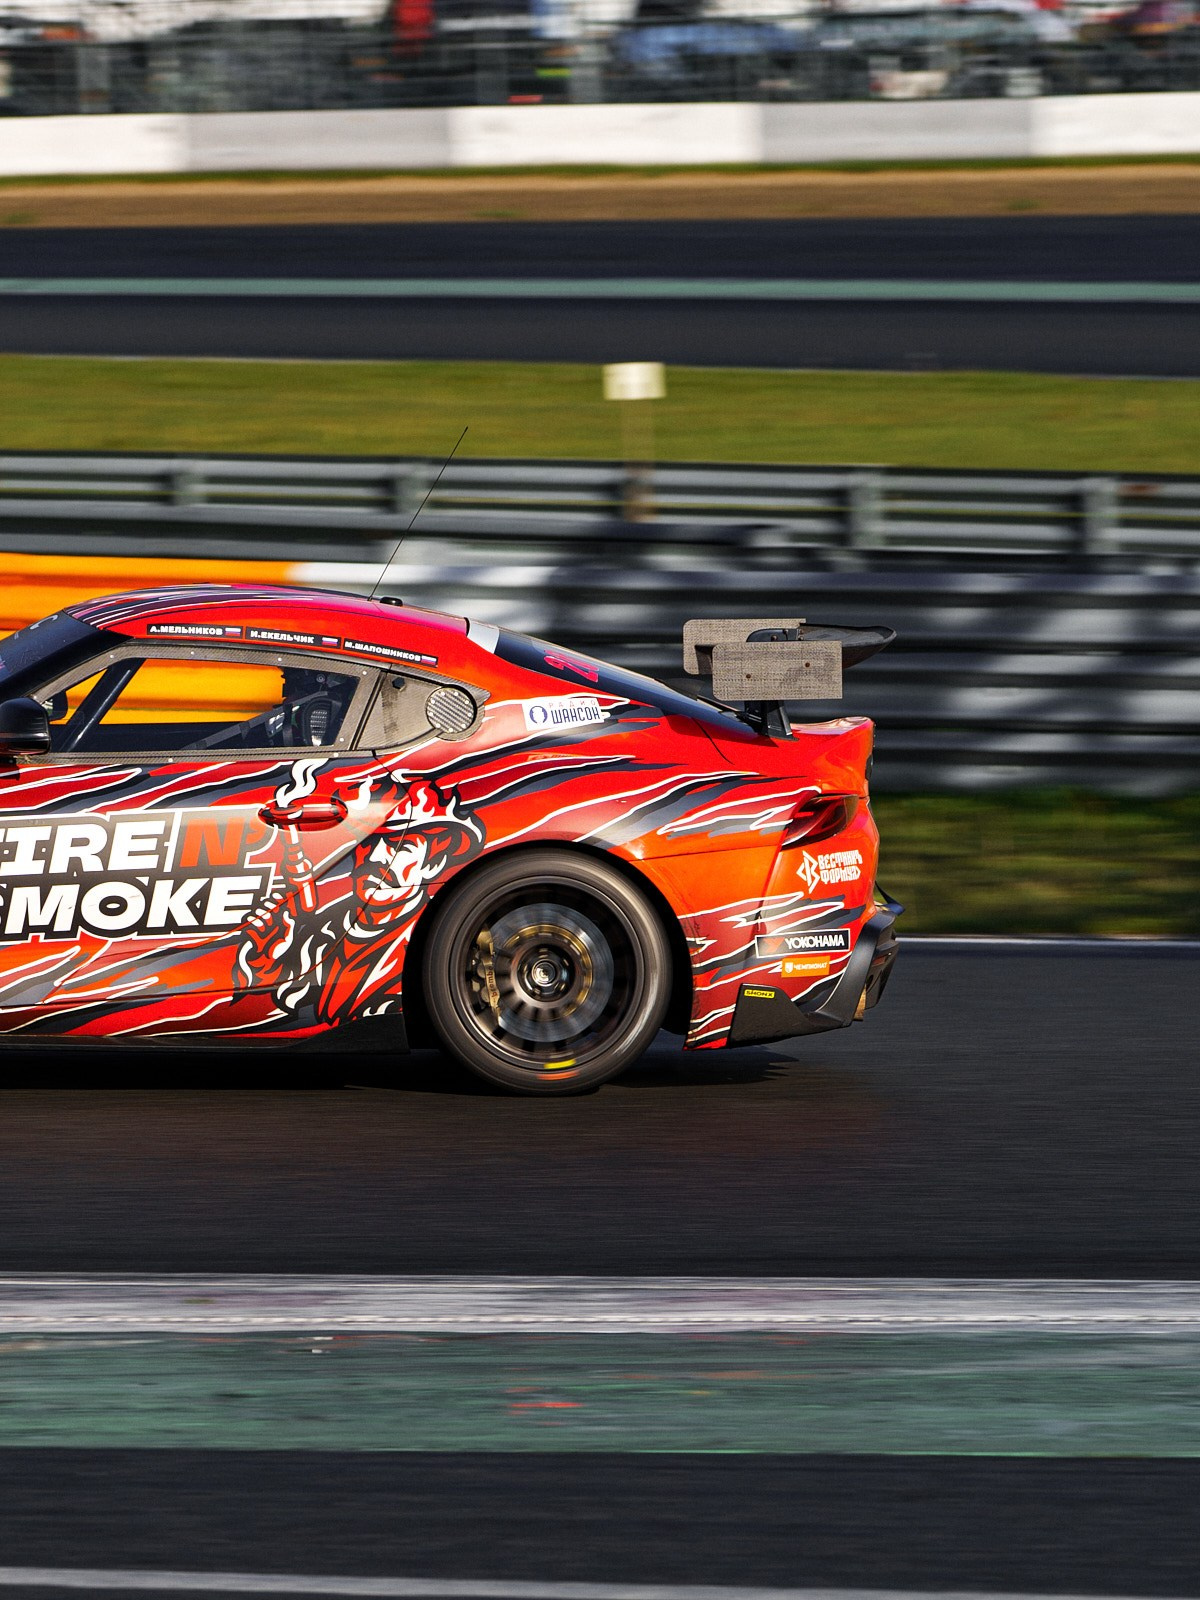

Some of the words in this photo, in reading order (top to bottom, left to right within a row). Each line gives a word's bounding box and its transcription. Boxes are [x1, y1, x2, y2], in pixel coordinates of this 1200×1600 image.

[149, 625, 223, 636] А.МЕЛЬНИКОВ
[250, 630, 315, 644] И.ЕКЕЛЬЧИК
[344, 641, 421, 662] М.ШАПОШНИКОВ
[550, 706, 601, 724] ШАНСОН
[784, 934, 845, 950] YOKOHAMA
